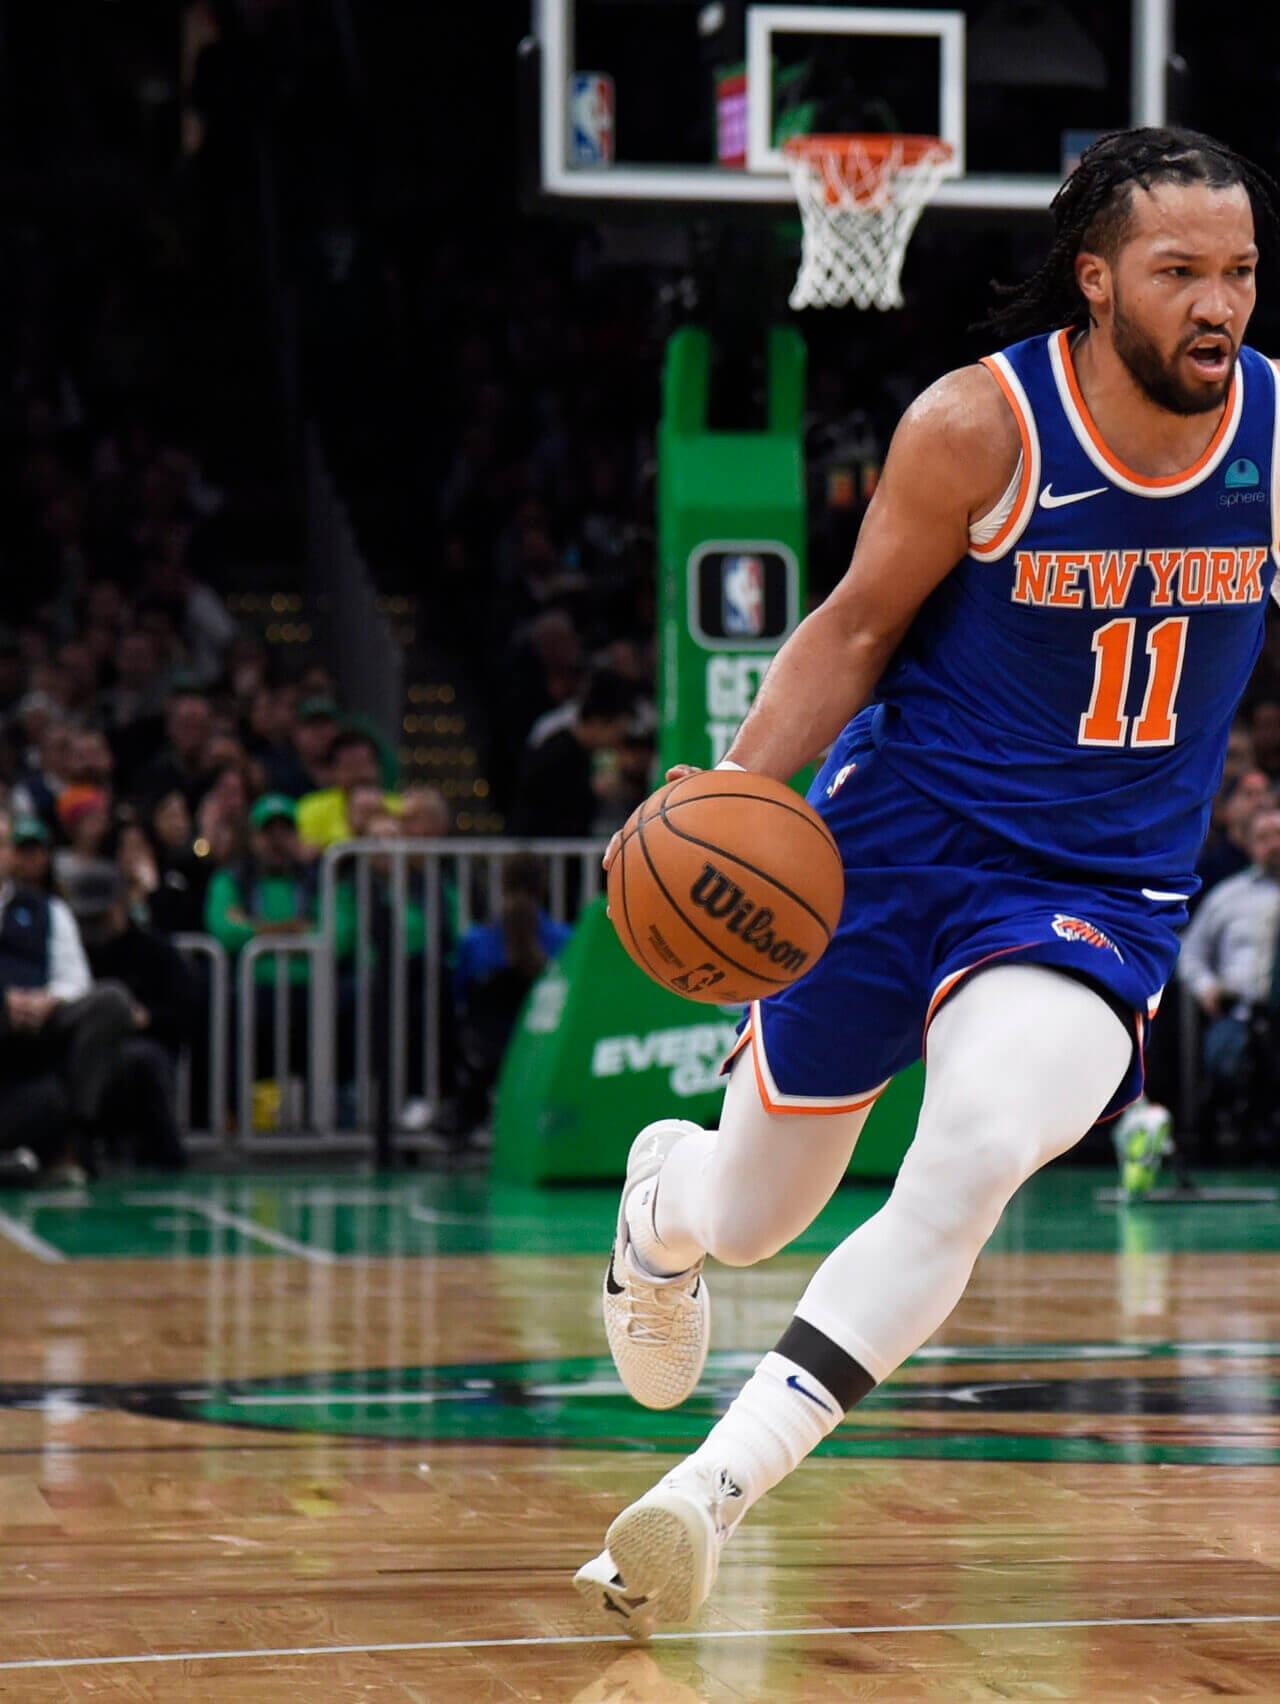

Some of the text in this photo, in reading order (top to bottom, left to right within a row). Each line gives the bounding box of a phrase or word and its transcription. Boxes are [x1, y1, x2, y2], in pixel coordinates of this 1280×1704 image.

[1219, 491, 1265, 508] sphere
[1011, 547, 1268, 609] NEW YORK
[706, 655, 774, 717] GE
[1077, 616, 1190, 748] 11
[690, 861, 809, 975] Wilson
